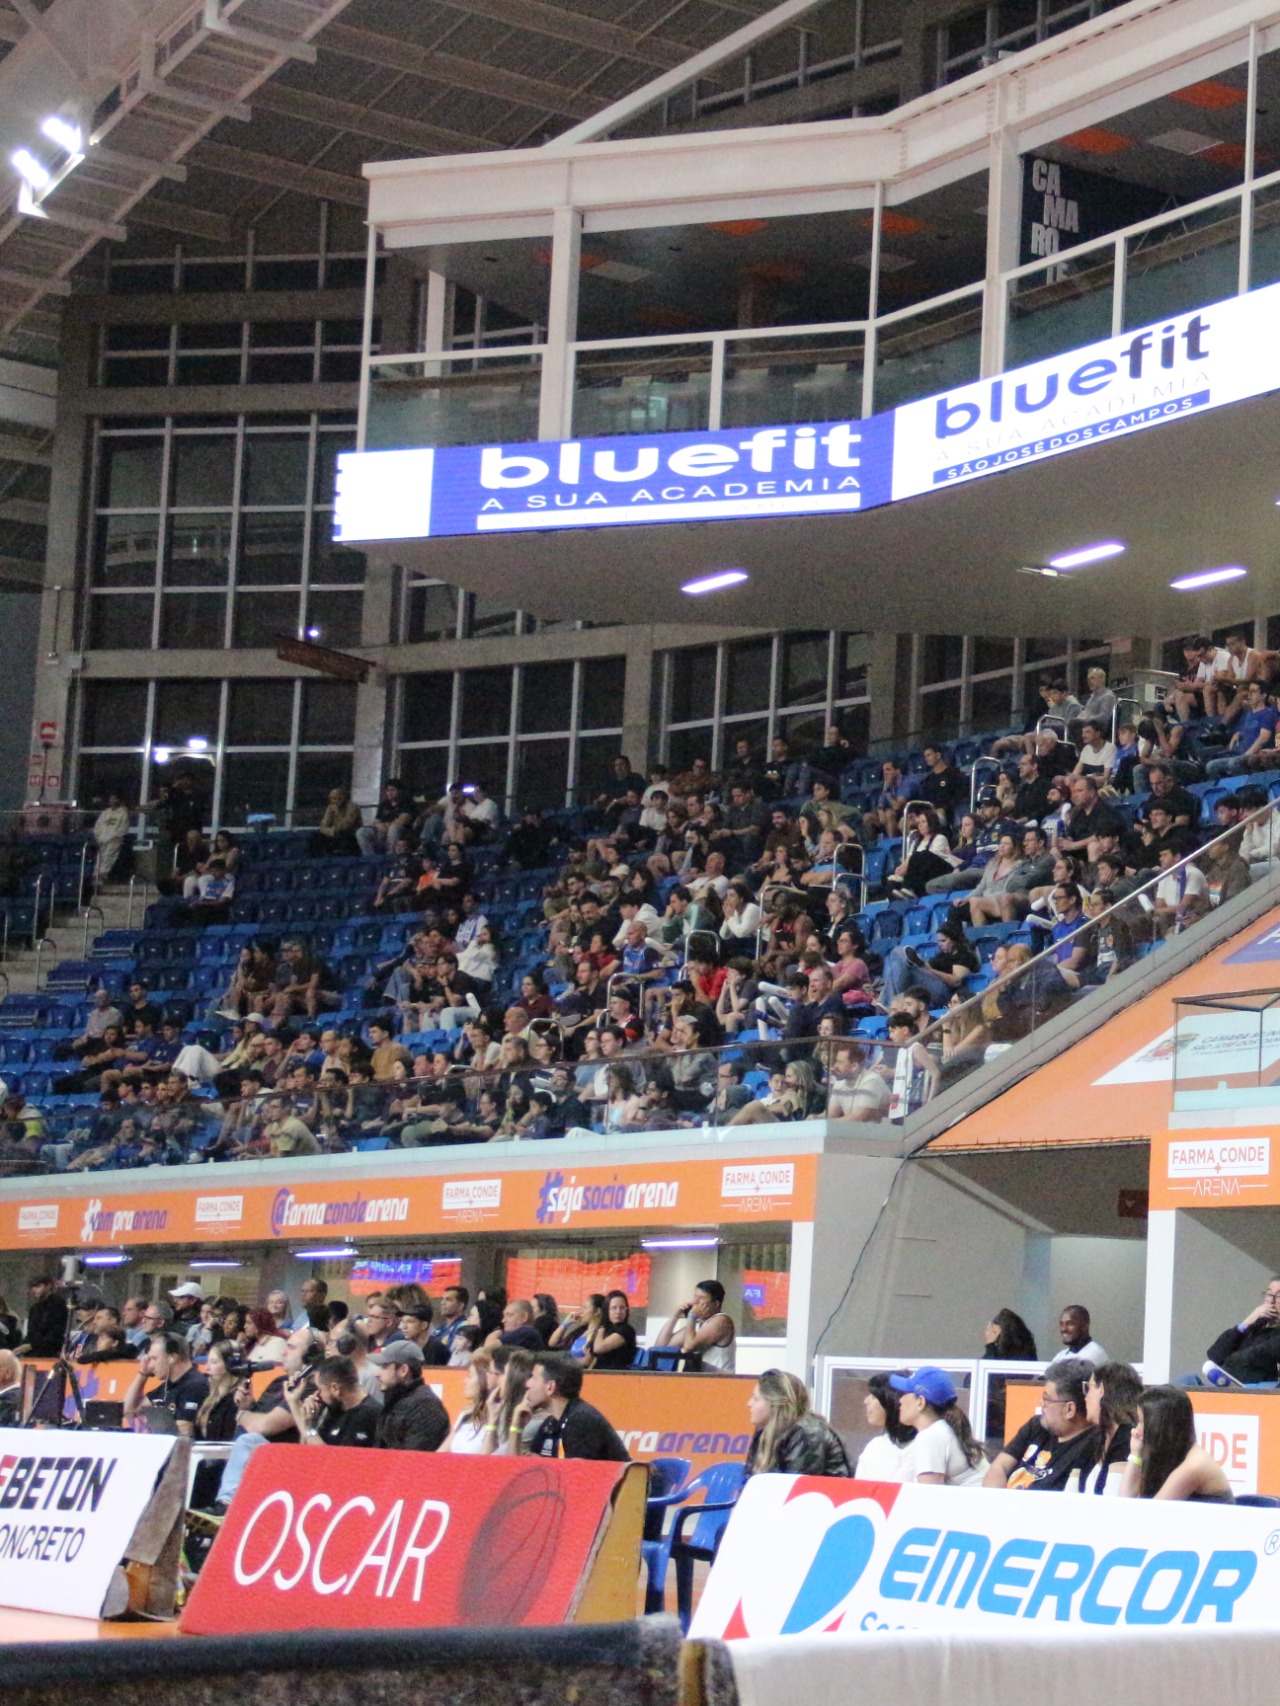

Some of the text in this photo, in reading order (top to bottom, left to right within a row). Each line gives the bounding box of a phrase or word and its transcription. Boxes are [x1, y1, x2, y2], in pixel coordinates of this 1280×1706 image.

[935, 314, 1211, 440] bluefit
[480, 424, 862, 490] bluefit
[992, 440, 1045, 468] JOSÉ
[1050, 427, 1094, 450] DOS
[1098, 397, 1193, 435] CAMPOS
[481, 475, 861, 511] A SUA ACADEMIA
[725, 1170, 791, 1185] FARMA CONDE
[1172, 1145, 1265, 1165] FARMA CONDE
[445, 1185, 499, 1199] FARMA CONDE
[1193, 1177, 1241, 1197] ARENA
[234, 1490, 450, 1602] OSCAR
[878, 1527, 1258, 1626] EMERCOR
